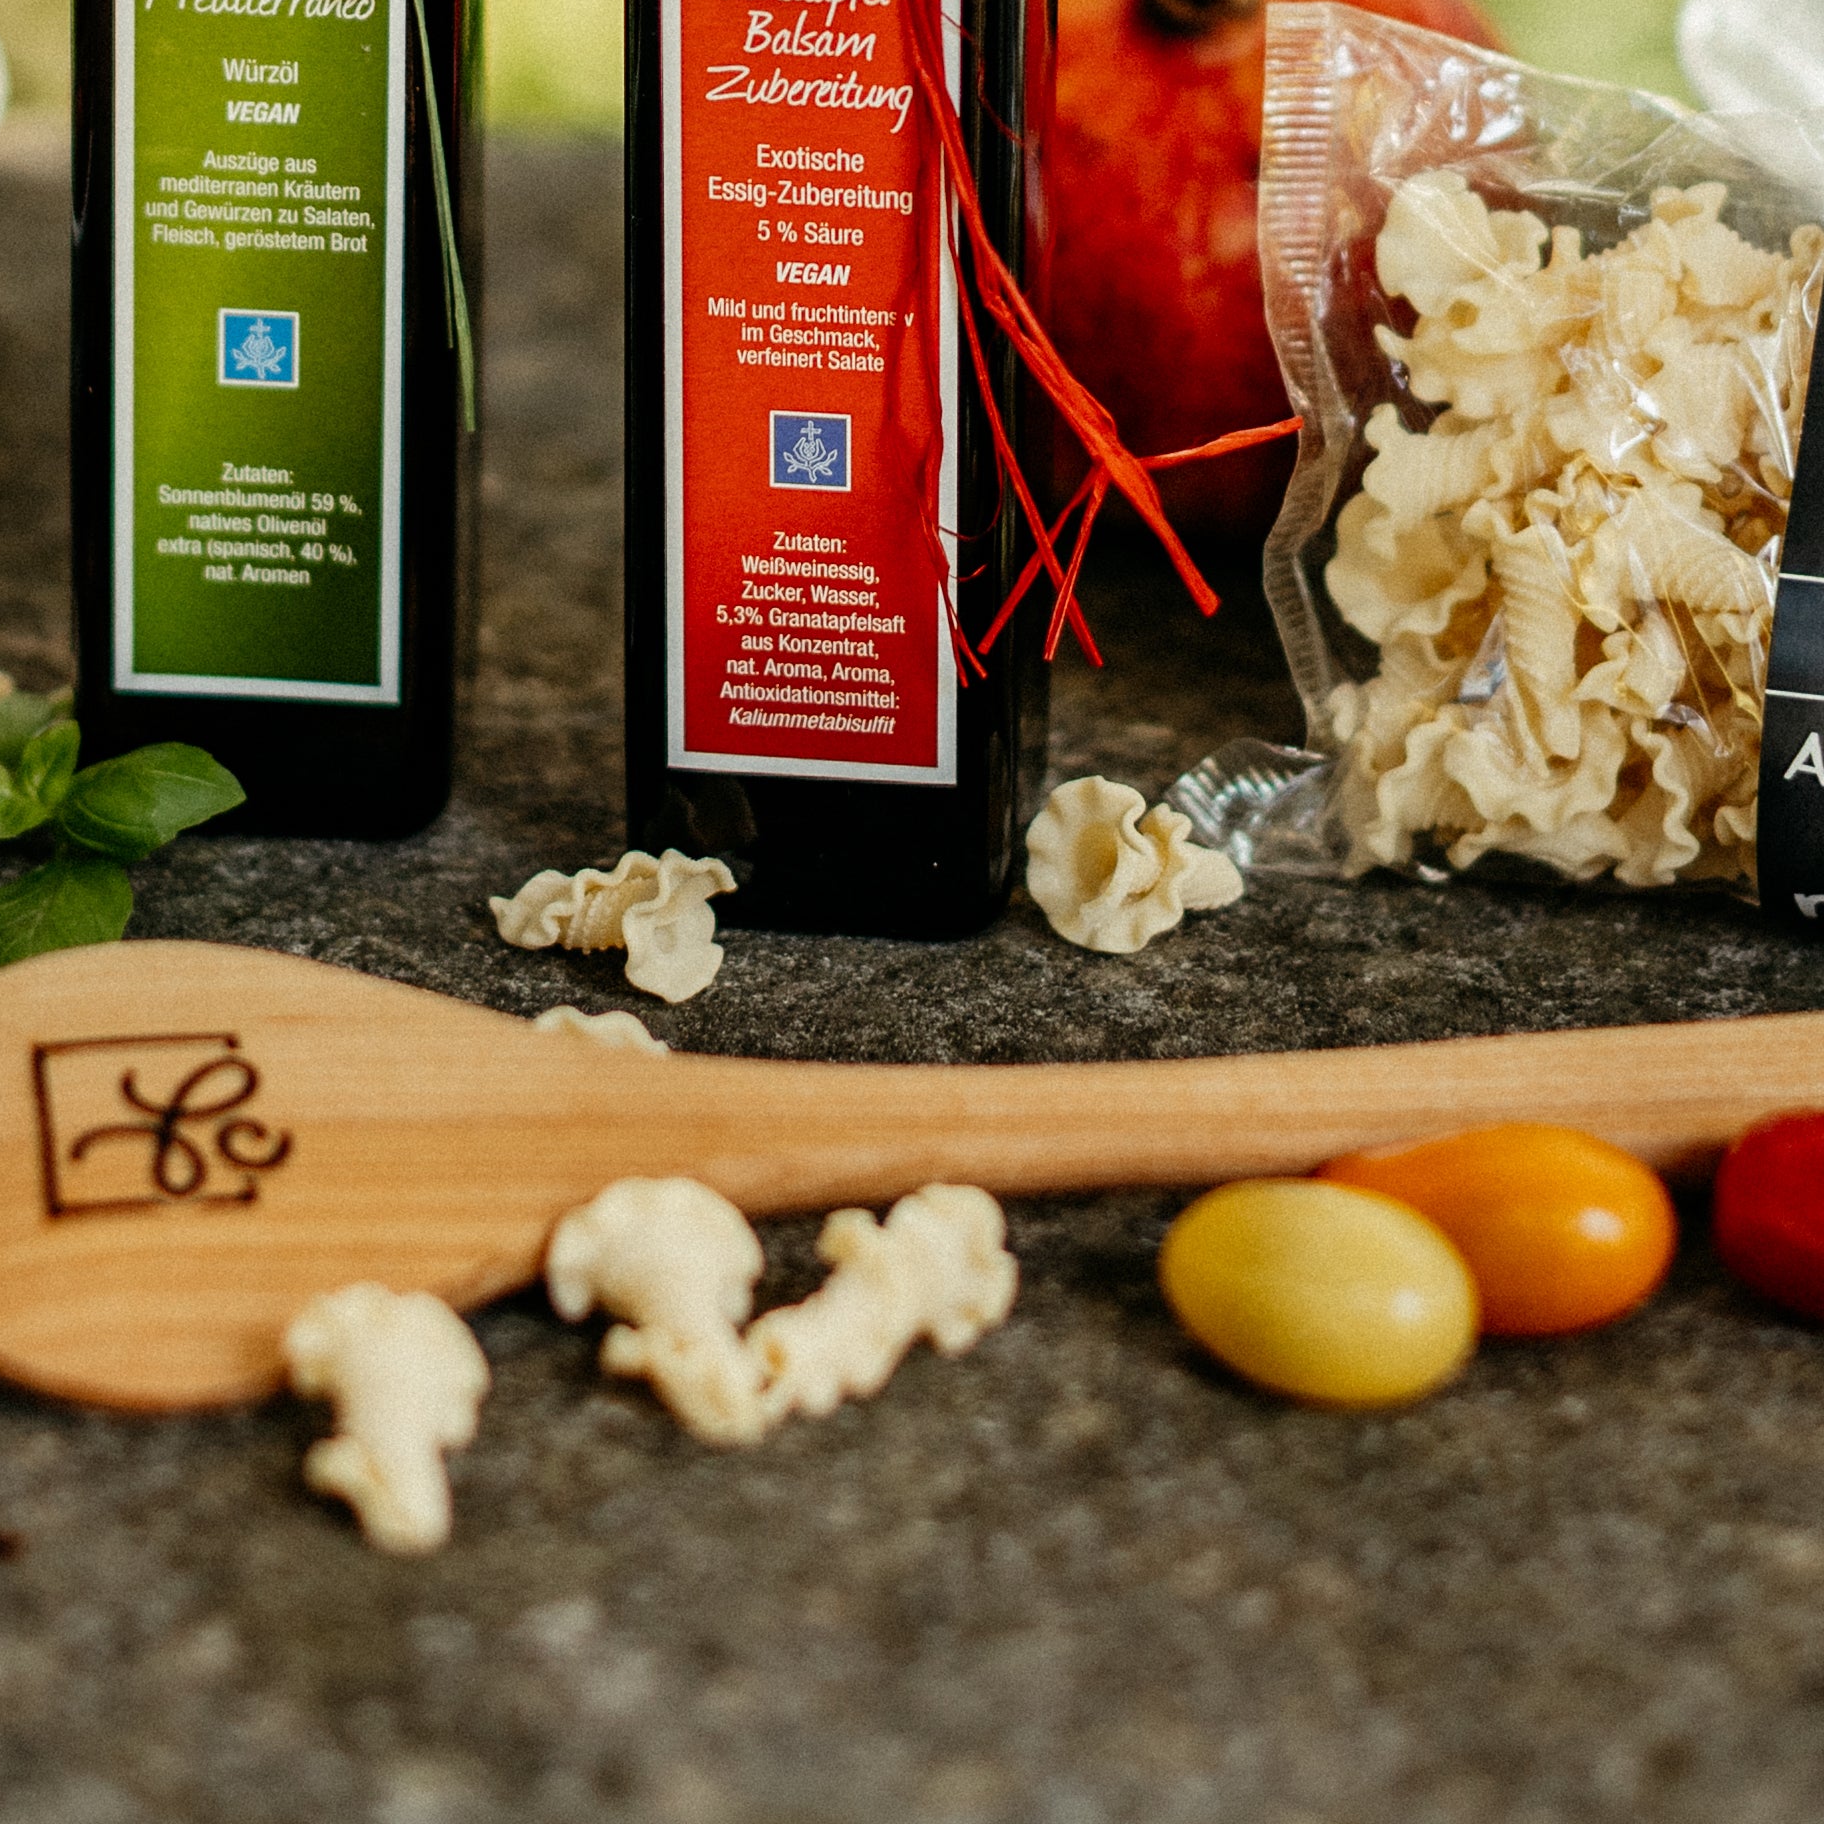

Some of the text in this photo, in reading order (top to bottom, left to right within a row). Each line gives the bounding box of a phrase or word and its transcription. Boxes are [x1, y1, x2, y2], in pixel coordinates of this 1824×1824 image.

[742, 9, 877, 62] Balsam
[222, 58, 299, 84] Würzöl
[227, 101, 301, 124] VEGAN
[704, 65, 914, 133] Zubereitung
[203, 149, 317, 175] Auszüge aus
[756, 143, 865, 173] Exotische
[160, 176, 360, 201] mediterranen Kräutern
[708, 176, 914, 216] Essig-Zubereitung
[145, 200, 376, 229] und Gewürzen zu Salaten,
[152, 224, 368, 253] Fleisch, geröstetem Brot
[756, 220, 864, 246] 5 % Säure
[775, 261, 851, 287] VEGAN
[707, 297, 915, 328] Mild und fruchtintensv
[740, 322, 881, 351] im Geschmack,
[737, 346, 885, 373] verfeinert Salate
[221, 462, 294, 485] Zutaten:
[158, 484, 306, 510] Sonnenblumenöl
[311, 493, 335, 512] 59
[189, 513, 327, 537] natives Olivenöl
[157, 537, 203, 555] extra
[300, 543, 324, 562] 40
[773, 531, 847, 553] Zutaten:
[204, 564, 311, 586] nat. Aromen
[741, 555, 880, 585] Weißweinessig,
[741, 580, 880, 610] Zucker, Wasser,
[716, 605, 906, 634] 5,3% Granatapfelsaft
[741, 633, 879, 660] aus Konzentrat,
[726, 658, 895, 686] nat. Aroma, Aroma,
[719, 681, 900, 709] Antioxidationsmittel:
[729, 707, 896, 735] Kaliummetabisulfit
